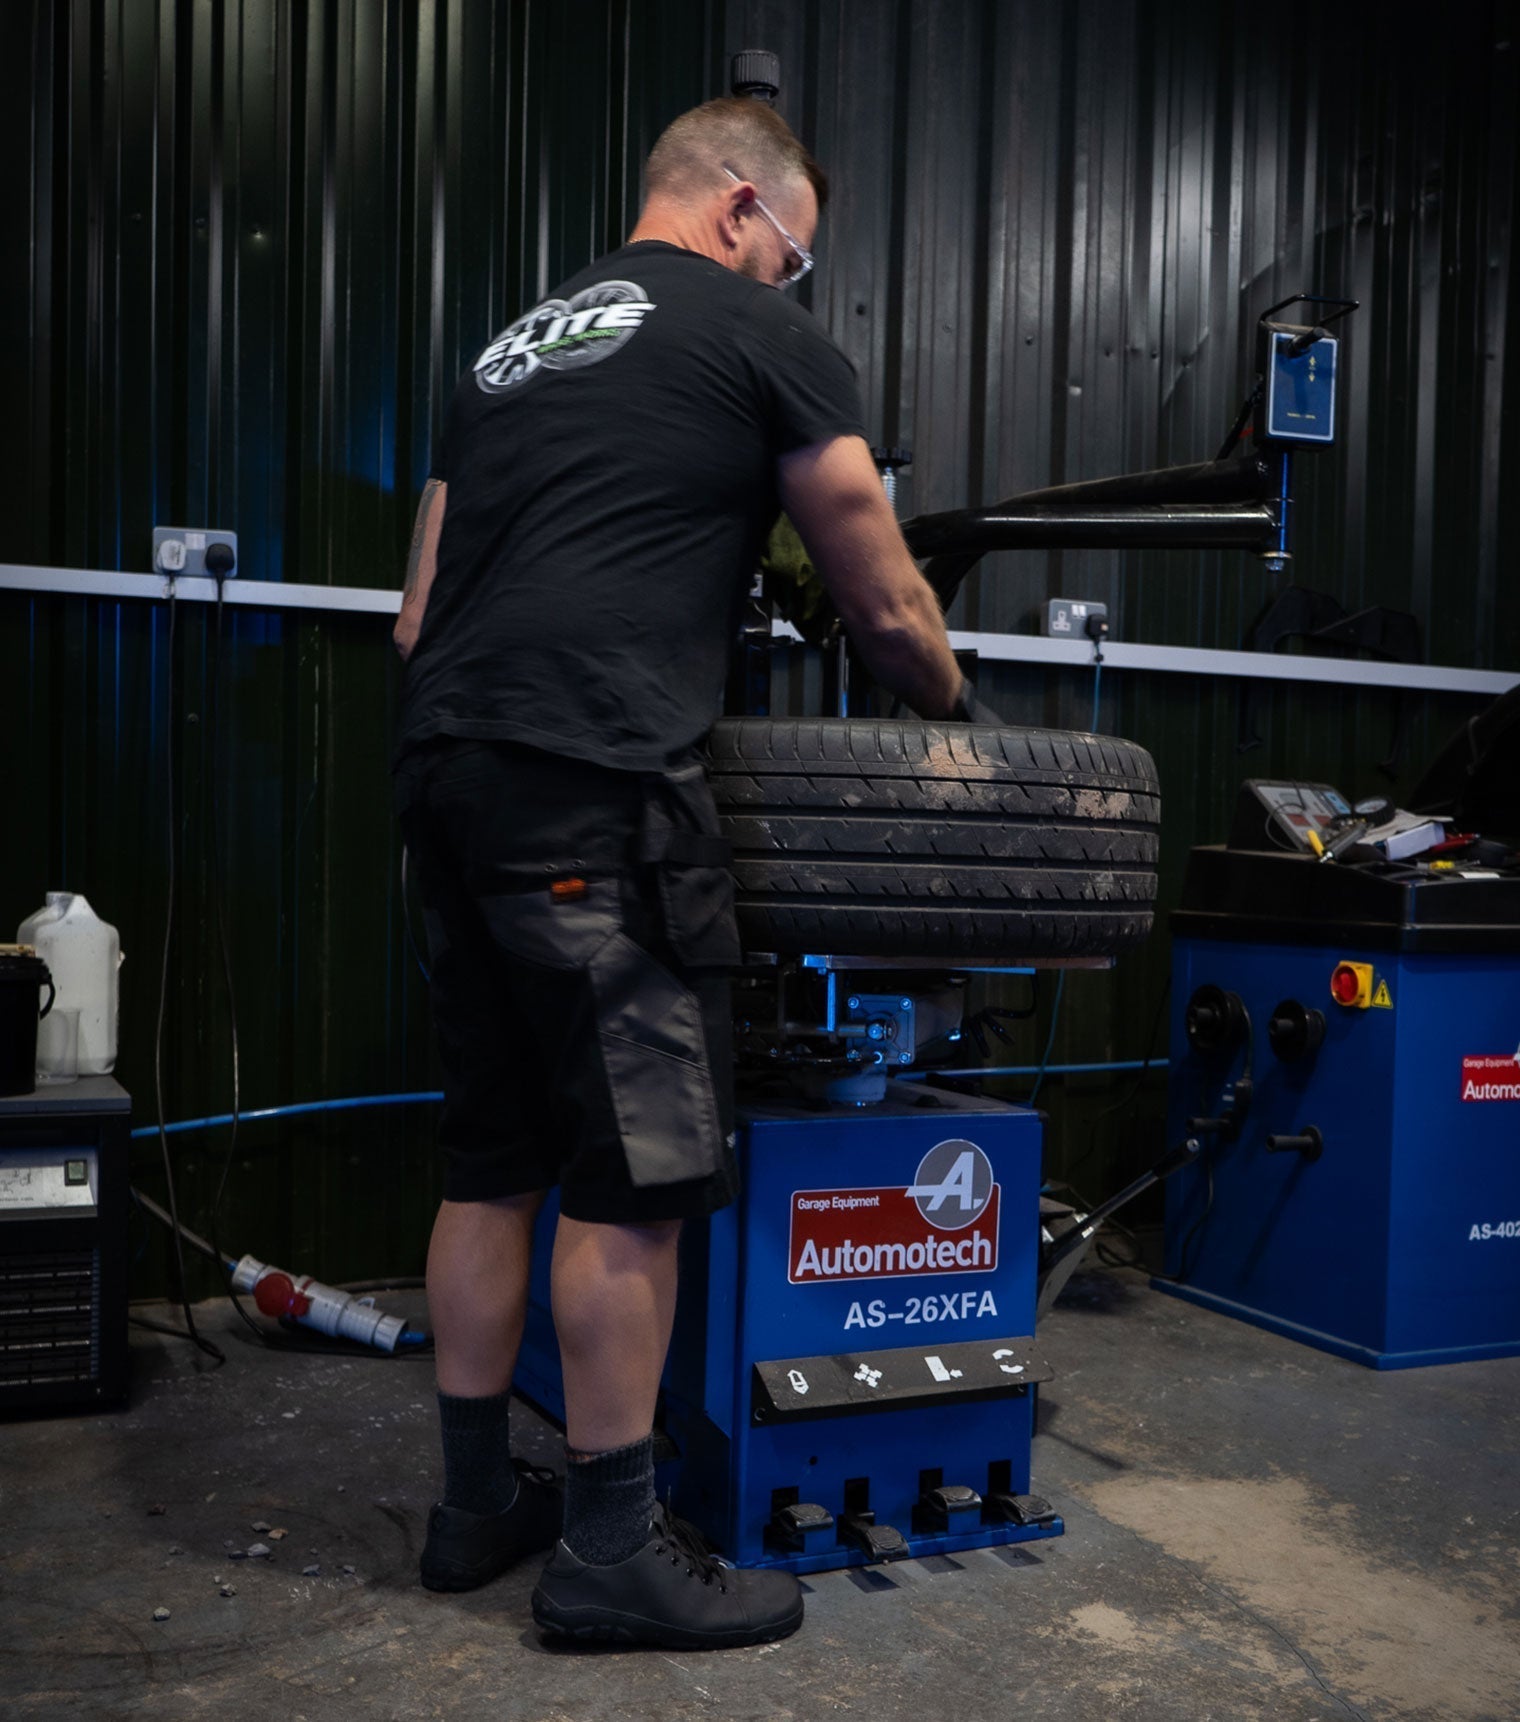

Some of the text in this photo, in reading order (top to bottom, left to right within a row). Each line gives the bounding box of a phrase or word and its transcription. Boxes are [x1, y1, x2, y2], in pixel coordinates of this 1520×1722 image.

[473, 303, 657, 371] ELITE
[1463, 1058, 1514, 1069] Garage Equipment
[797, 1195, 880, 1211] Garage Equipment
[794, 1230, 991, 1277] Automotech
[843, 1290, 998, 1330] AS-26XFA
